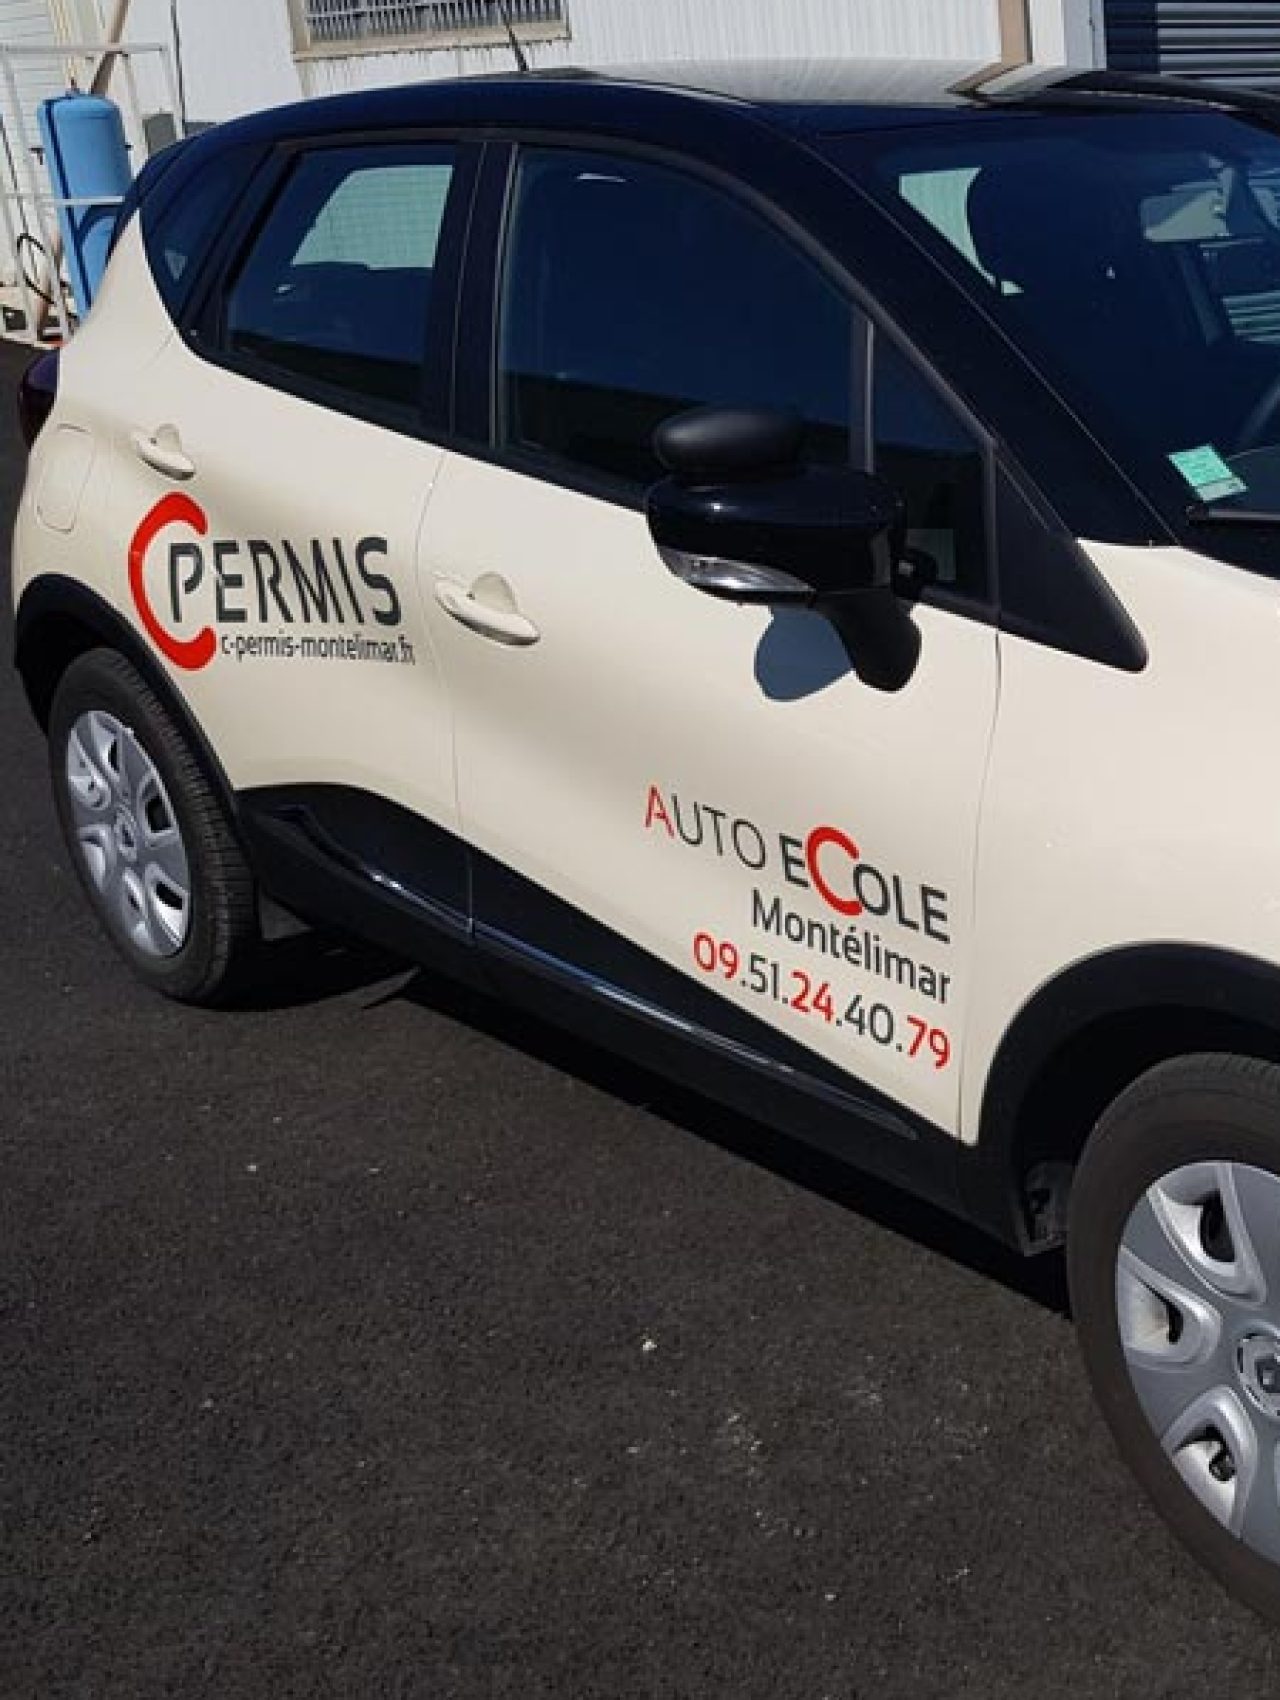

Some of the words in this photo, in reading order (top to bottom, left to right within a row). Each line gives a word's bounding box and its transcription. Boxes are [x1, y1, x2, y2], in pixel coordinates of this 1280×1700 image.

[645, 785, 767, 869] AUTO
[692, 930, 951, 1070] 09.51.24.40.79
[752, 886, 951, 1004] Montélimar
